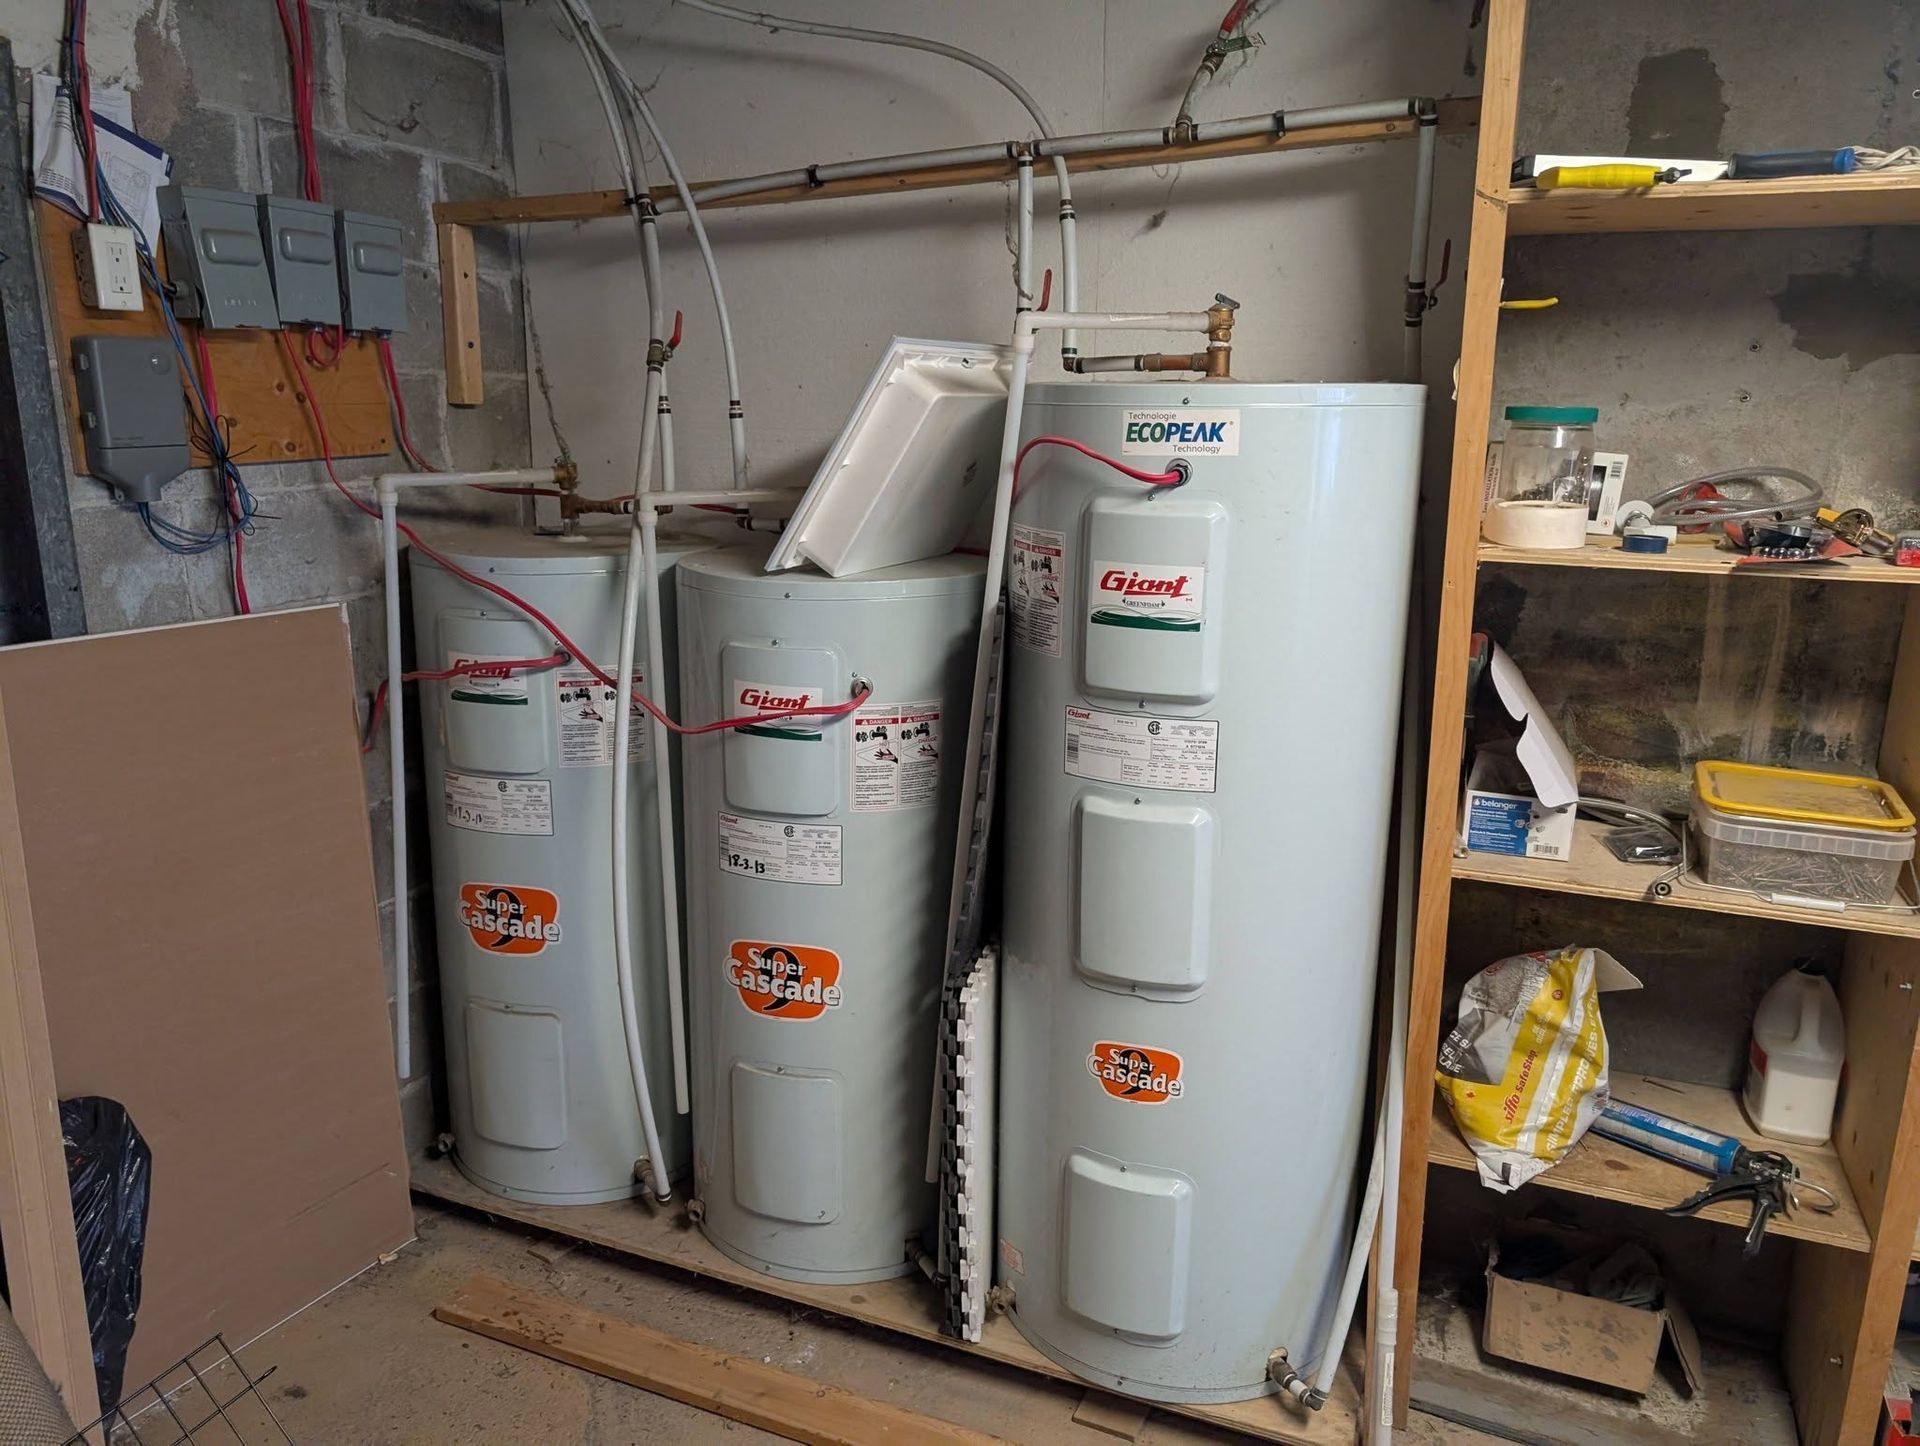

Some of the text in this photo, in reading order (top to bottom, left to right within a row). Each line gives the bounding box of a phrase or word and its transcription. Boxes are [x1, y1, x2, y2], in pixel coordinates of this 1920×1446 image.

[1129, 412, 1176, 421] Technologie
[1126, 422, 1227, 442] ECOPEAK
[1173, 445, 1221, 454] Technology
[1100, 570, 1190, 598] Giant
[739, 688, 811, 709] Giant
[474, 890, 528, 915] Super
[459, 900, 561, 942] Cascade
[747, 947, 807, 976] Super
[724, 958, 841, 1007] Cascade
[1108, 1048, 1155, 1071] Super
[1087, 1055, 1182, 1096] Cascade
